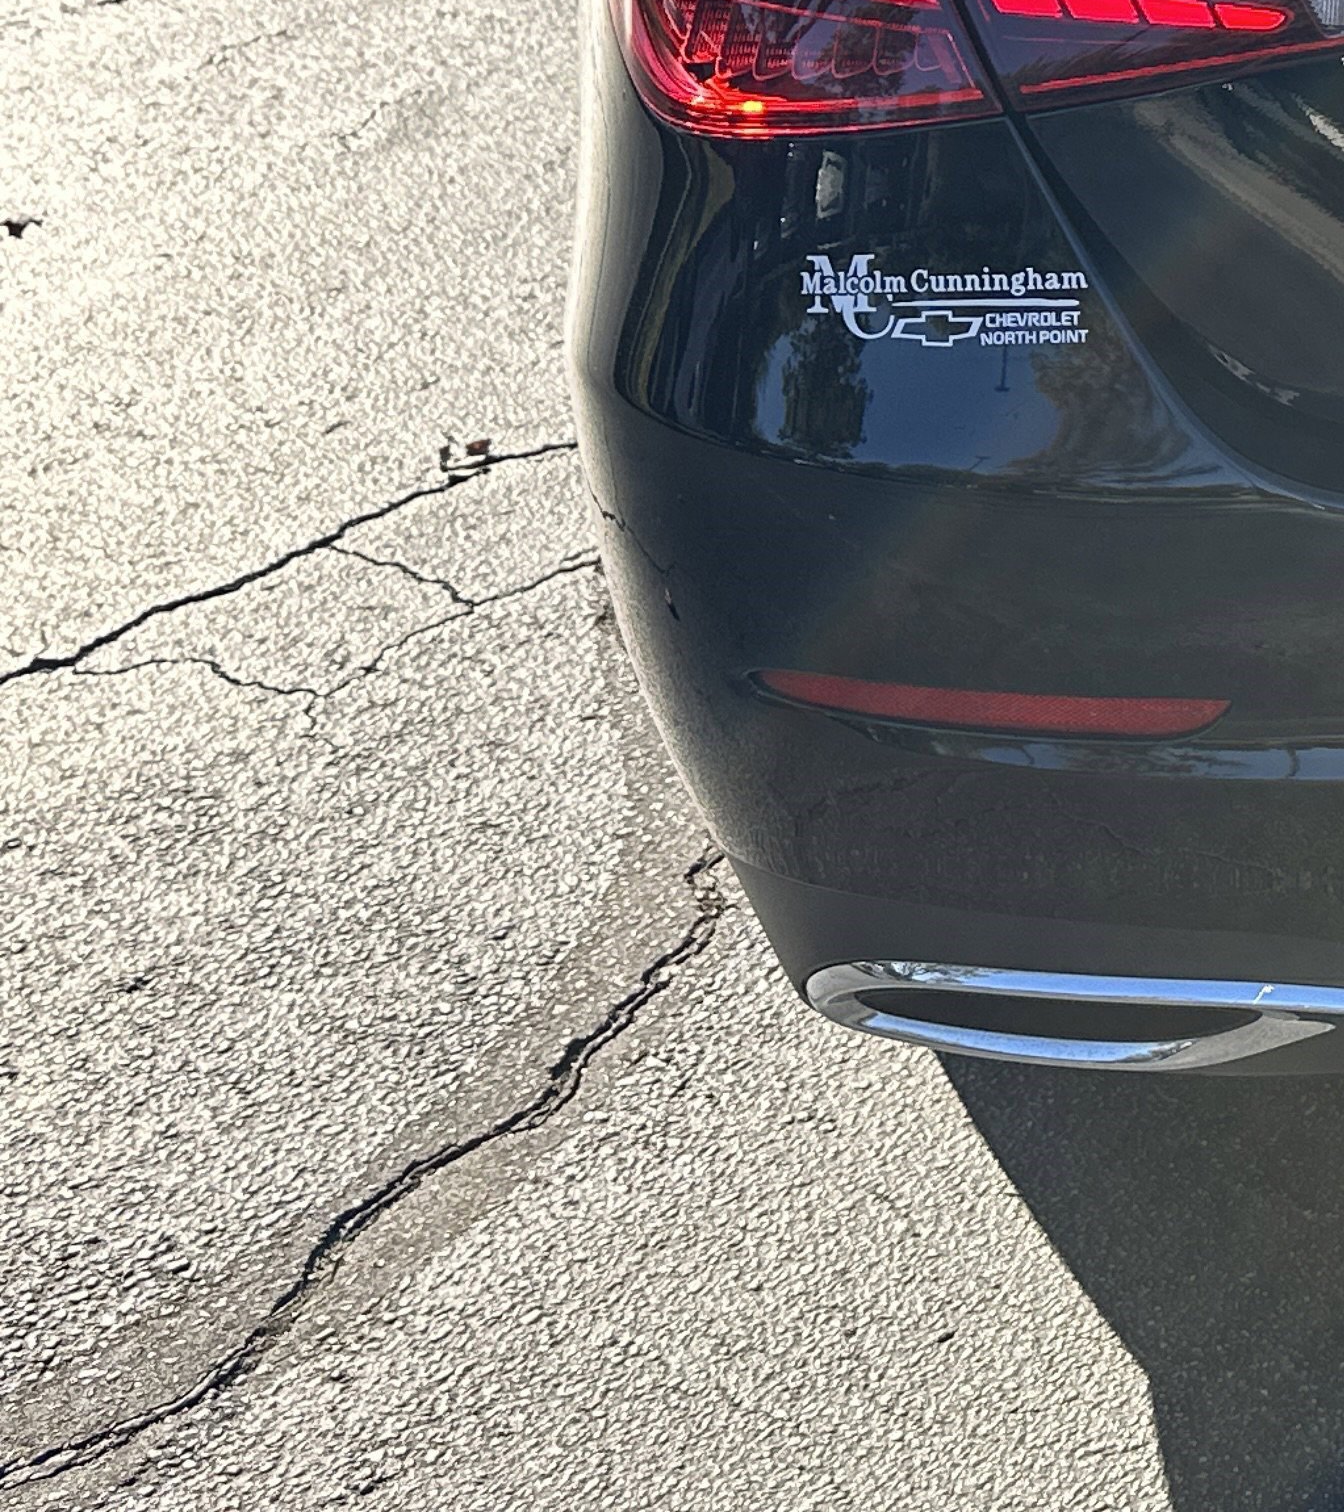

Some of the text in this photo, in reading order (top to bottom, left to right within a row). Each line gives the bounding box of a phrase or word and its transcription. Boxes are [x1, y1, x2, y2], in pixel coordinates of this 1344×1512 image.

[801, 267, 1089, 297] Malcolm Cunningham
[984, 310, 1081, 329] CHEVROLET
[980, 329, 1089, 346] NORTH POINT
